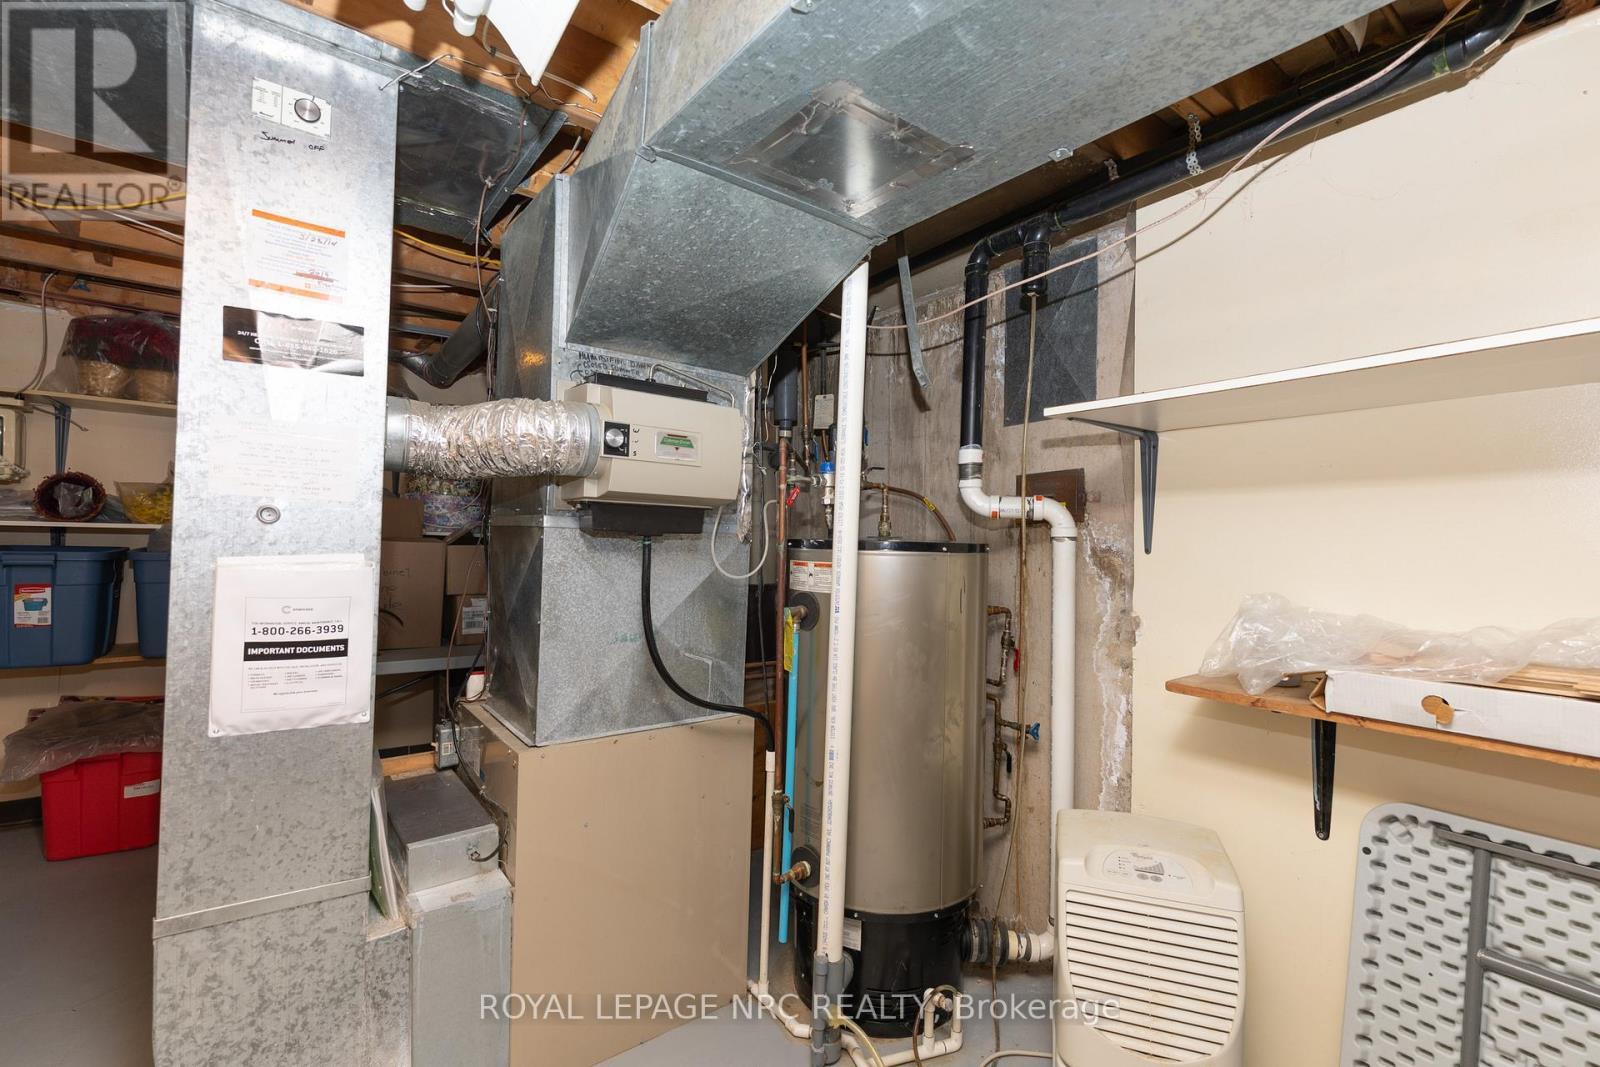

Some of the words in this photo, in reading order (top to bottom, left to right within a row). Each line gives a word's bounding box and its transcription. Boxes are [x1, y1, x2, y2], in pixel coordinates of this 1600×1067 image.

[251, 624, 344, 635] 1-800-266-3939
[247, 646, 295, 655] IMPORTANT
[296, 644, 345, 654] DOCUMENTS
